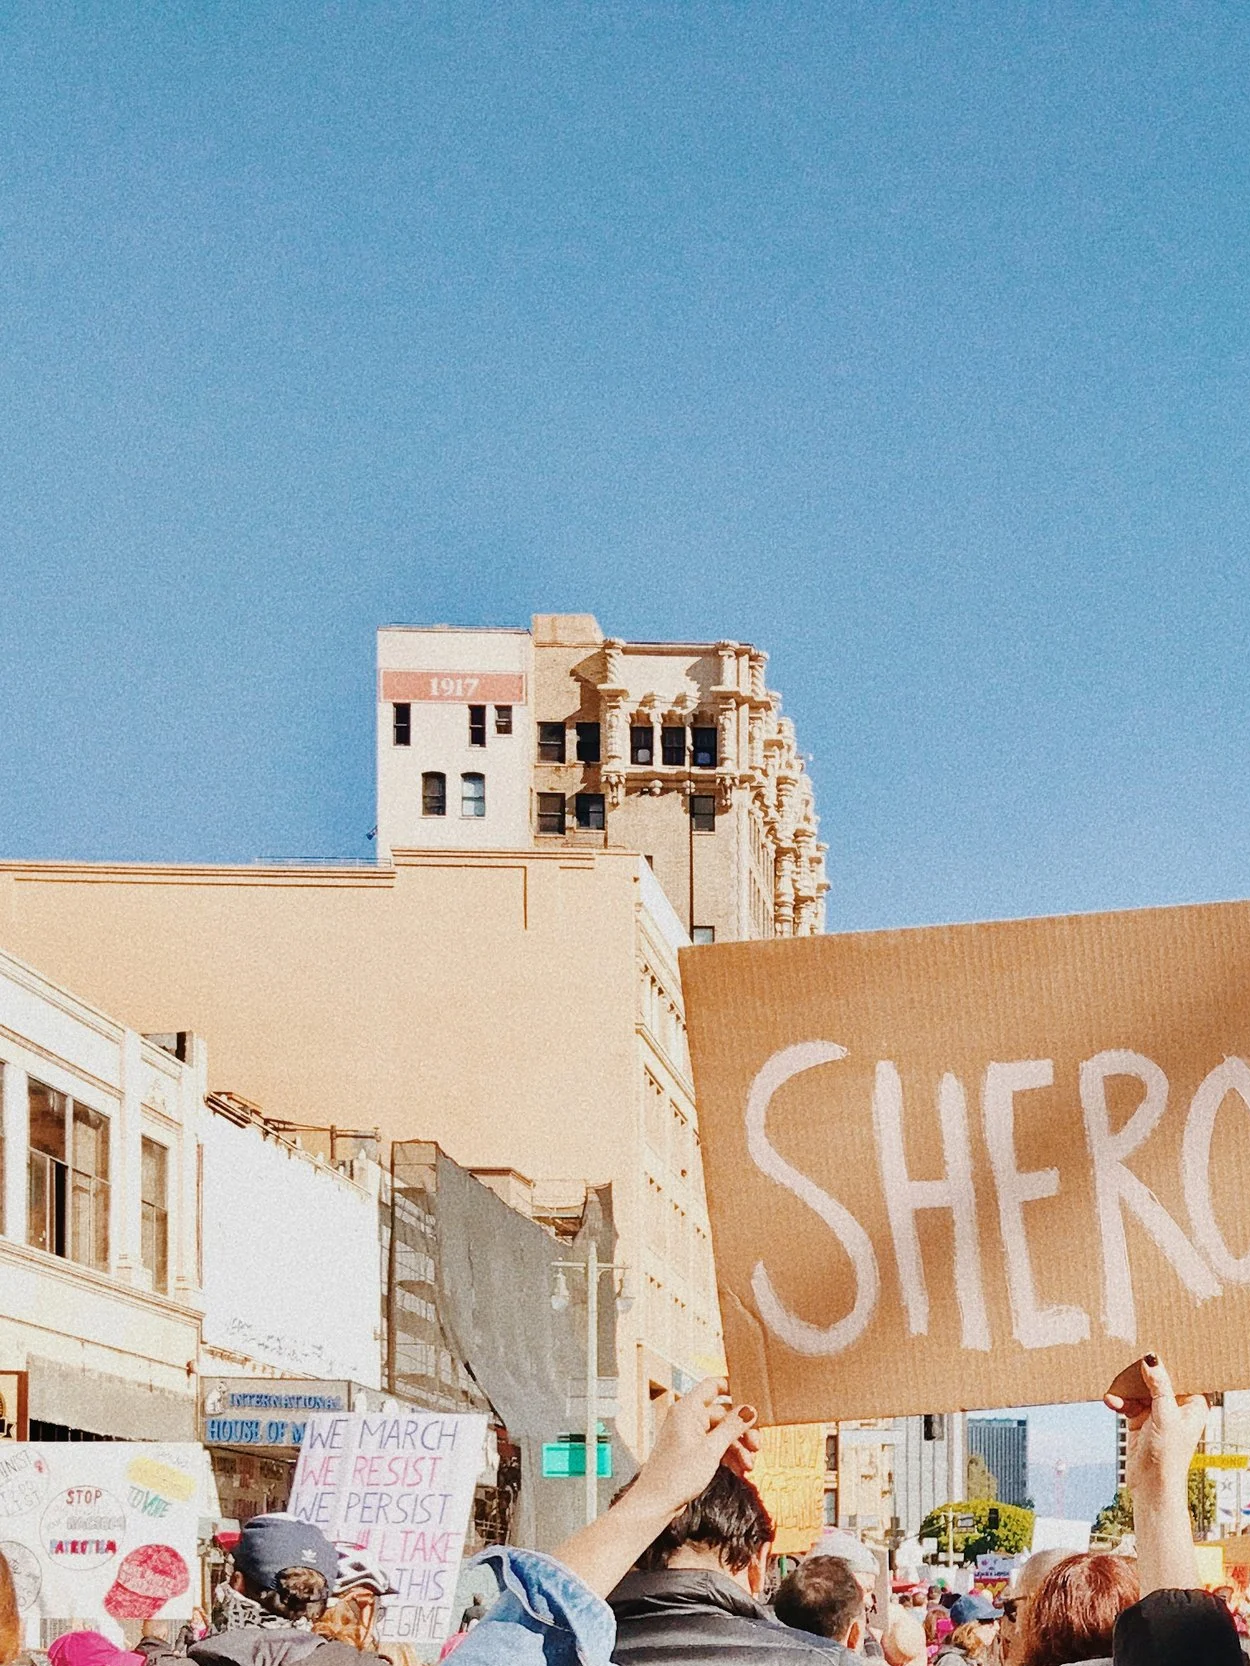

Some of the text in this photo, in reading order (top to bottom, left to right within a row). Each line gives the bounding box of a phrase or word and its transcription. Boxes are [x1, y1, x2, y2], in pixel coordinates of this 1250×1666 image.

[430, 677, 480, 697] 1917
[229, 1392, 343, 1410] INTERNATIONAL
[207, 1418, 261, 1443] HOUSE
[266, 1420, 288, 1444] OF
[309, 1418, 459, 1450] WE MARCH
[301, 1456, 443, 1487] WE RESIST
[66, 1490, 102, 1505] STOP
[295, 1492, 453, 1524] WE PERSIST
[400, 1530, 462, 1564] TAKE
[395, 1568, 447, 1600] THIS
[377, 1605, 451, 1639] REGIME
